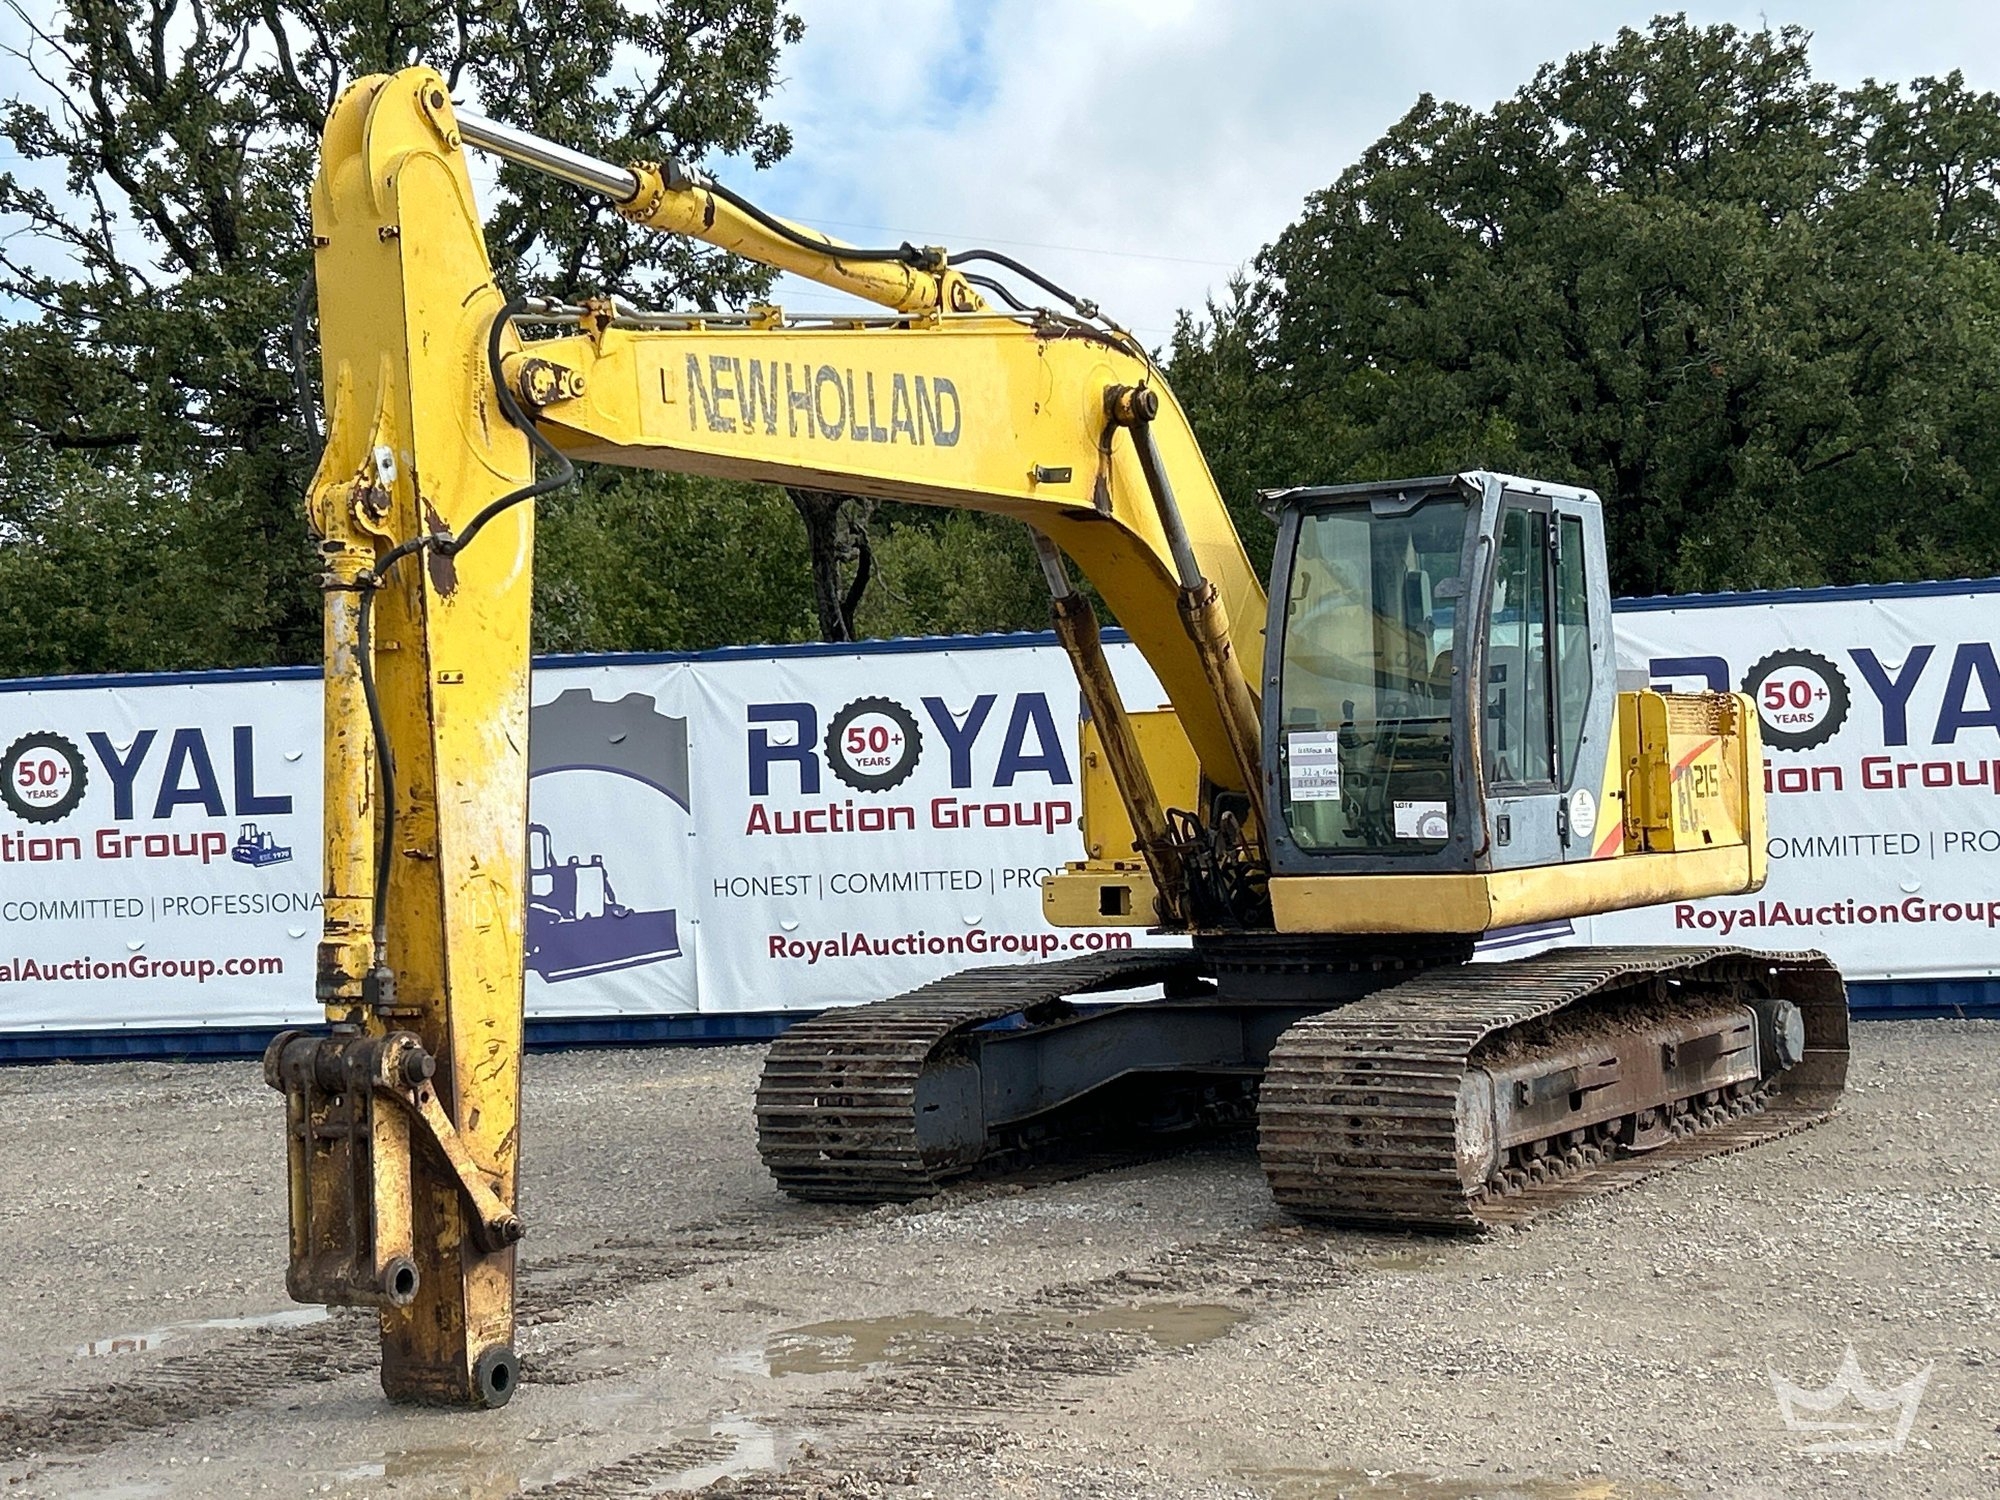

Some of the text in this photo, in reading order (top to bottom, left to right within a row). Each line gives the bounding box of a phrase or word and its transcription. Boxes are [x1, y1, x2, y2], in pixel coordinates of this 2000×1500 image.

[1763, 680, 1828, 710] 50+
[1773, 712, 1815, 724] YEARS
[846, 725, 903, 754] 50+
[17, 760, 70, 787] 50+
[855, 756, 891, 767] YEARS
[25, 789, 59, 799] YEARS
[746, 797, 1072, 836] Auction Group
[95, 829, 227, 865] Group
[1766, 833, 1920, 860] OMMITTED
[713, 875, 811, 898] HONEST
[830, 869, 982, 895] COMMITTED
[2, 897, 144, 922] COMMITTED
[769, 929, 1132, 965] RoyalAuctionGroup.com
